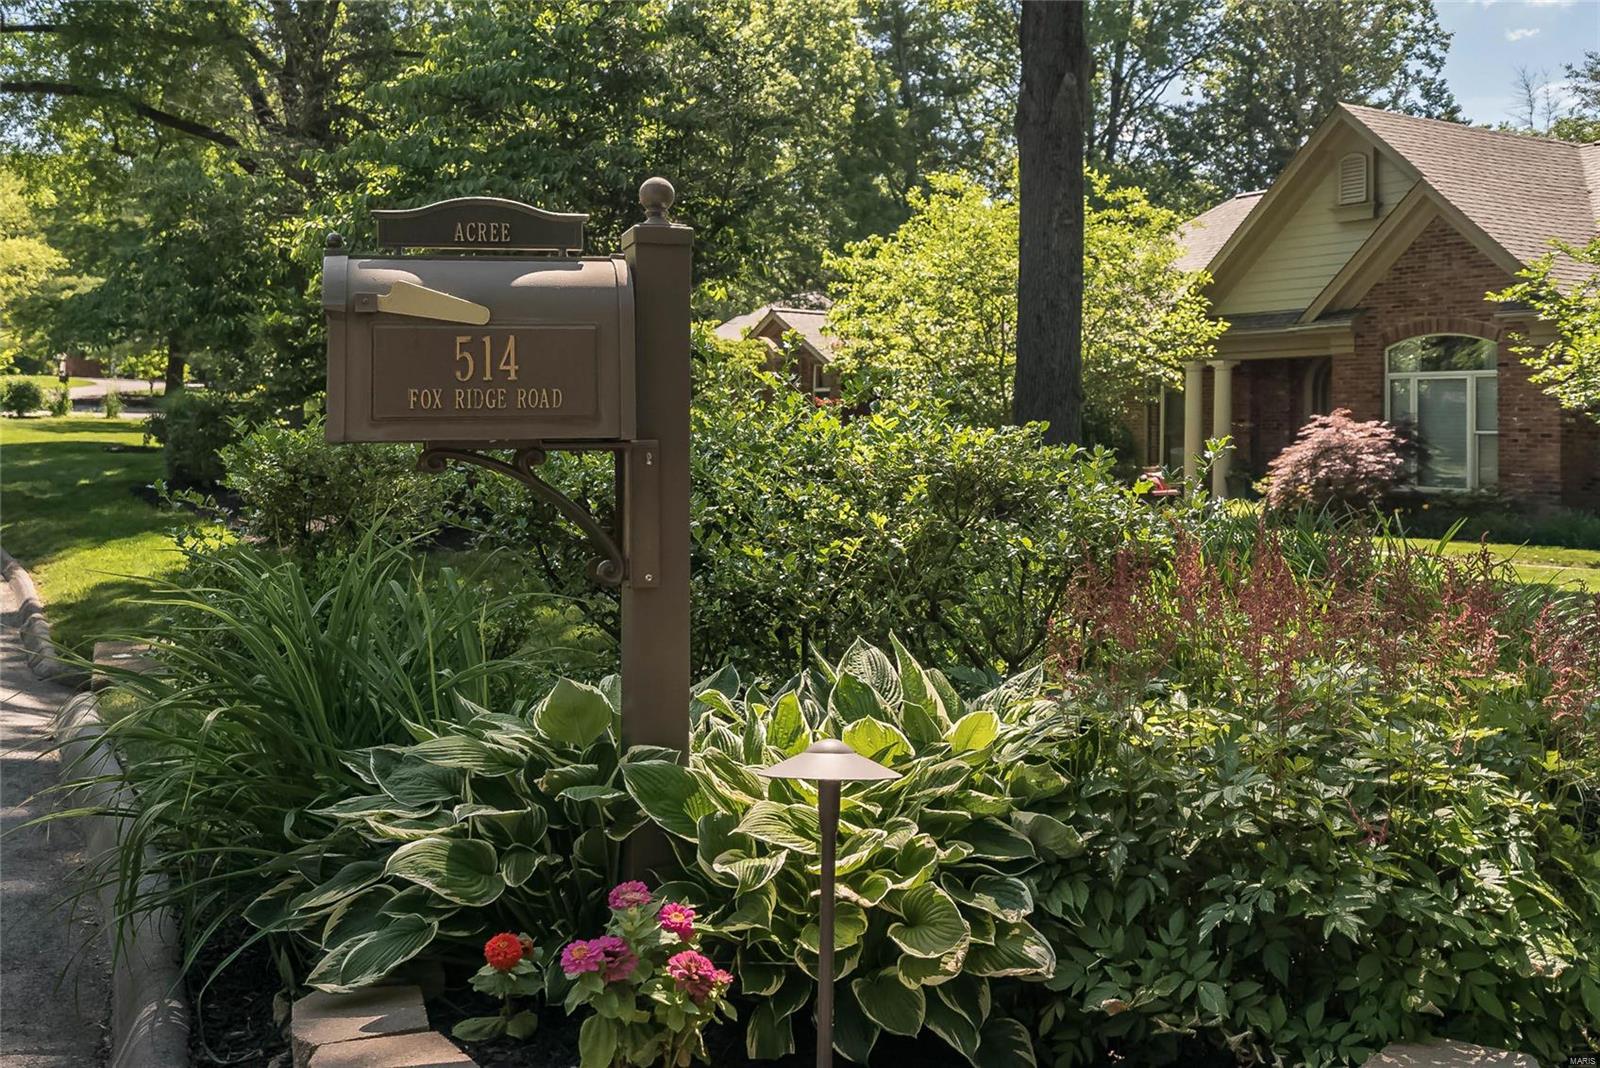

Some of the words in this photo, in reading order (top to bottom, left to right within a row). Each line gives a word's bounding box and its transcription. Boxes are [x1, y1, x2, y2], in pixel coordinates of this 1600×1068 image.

[454, 222, 511, 242] ACREE
[455, 335, 519, 382] 514
[408, 388, 443, 409] FOX
[455, 388, 507, 409] RIDGE
[517, 388, 563, 409] ROAD
